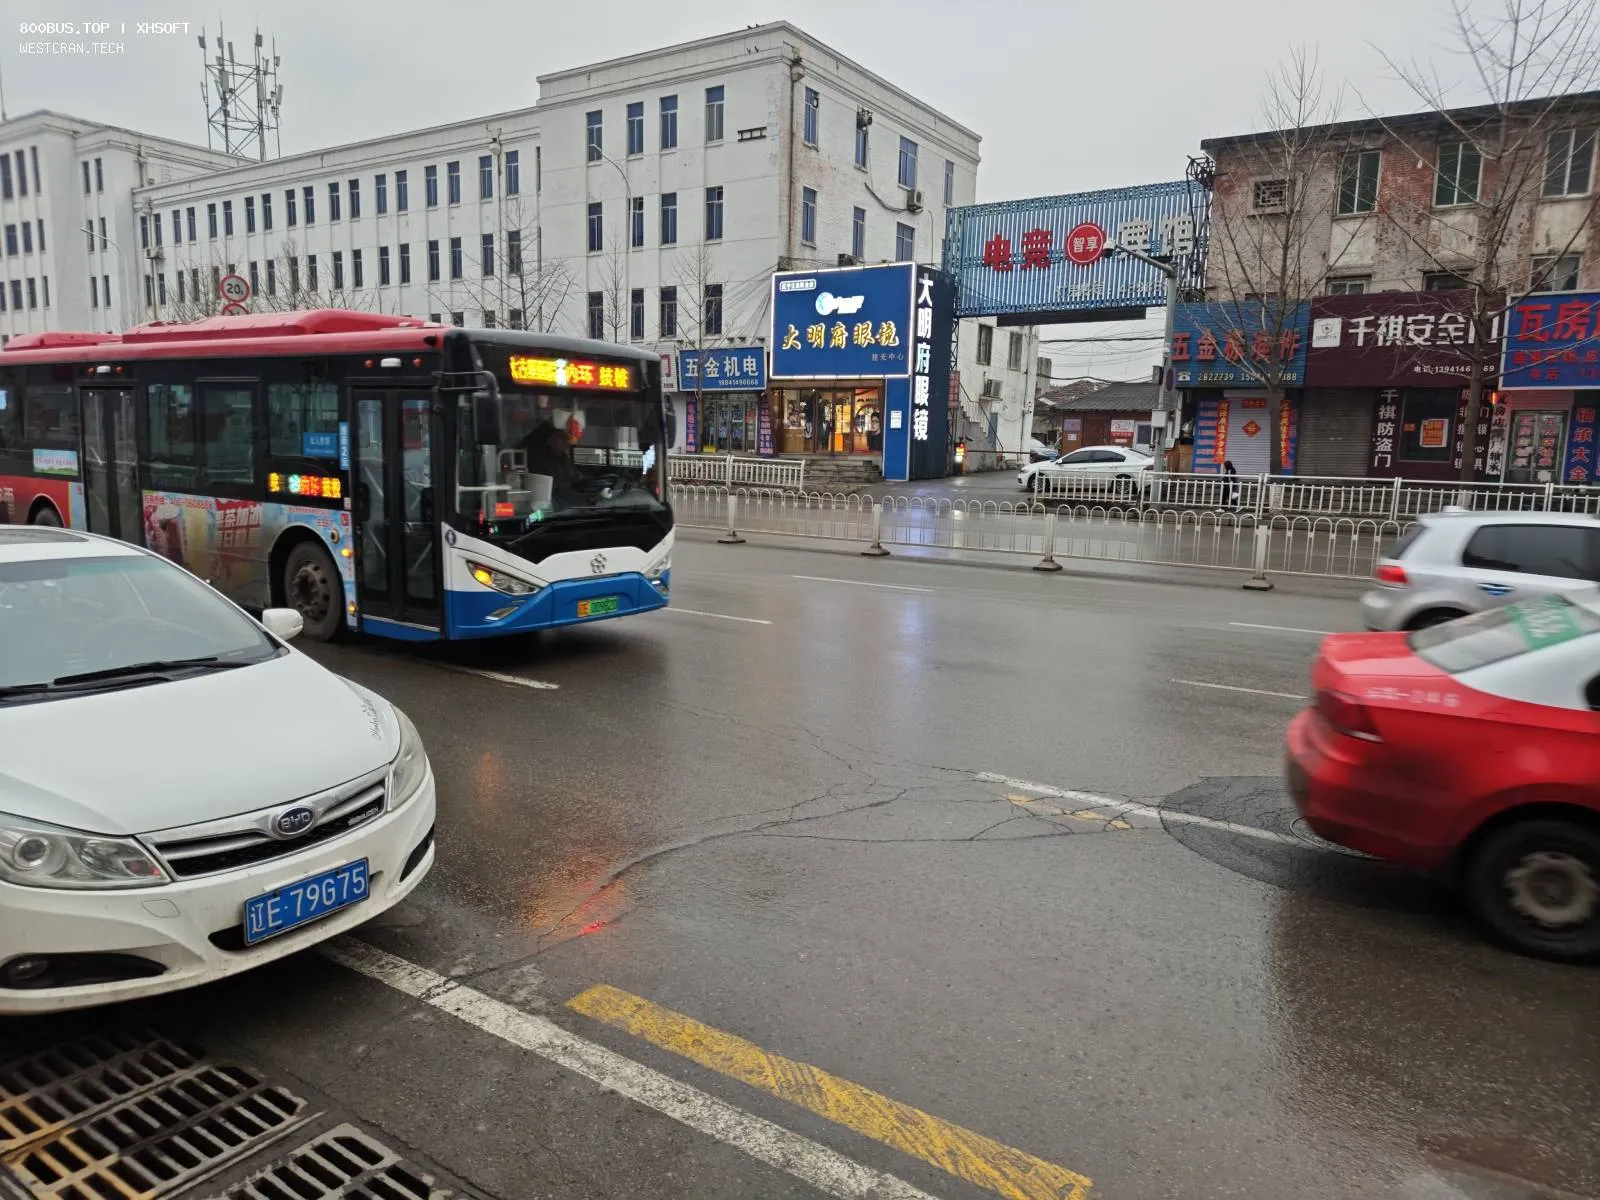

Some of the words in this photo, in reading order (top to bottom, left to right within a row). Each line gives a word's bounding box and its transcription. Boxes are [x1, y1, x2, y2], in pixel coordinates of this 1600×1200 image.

[1515, 299, 1600, 342] 瓦房
[684, 355, 759, 378] 五金机电
[912, 272, 934, 442] 大明府眼镜
[280, 812, 312, 830] BYD
